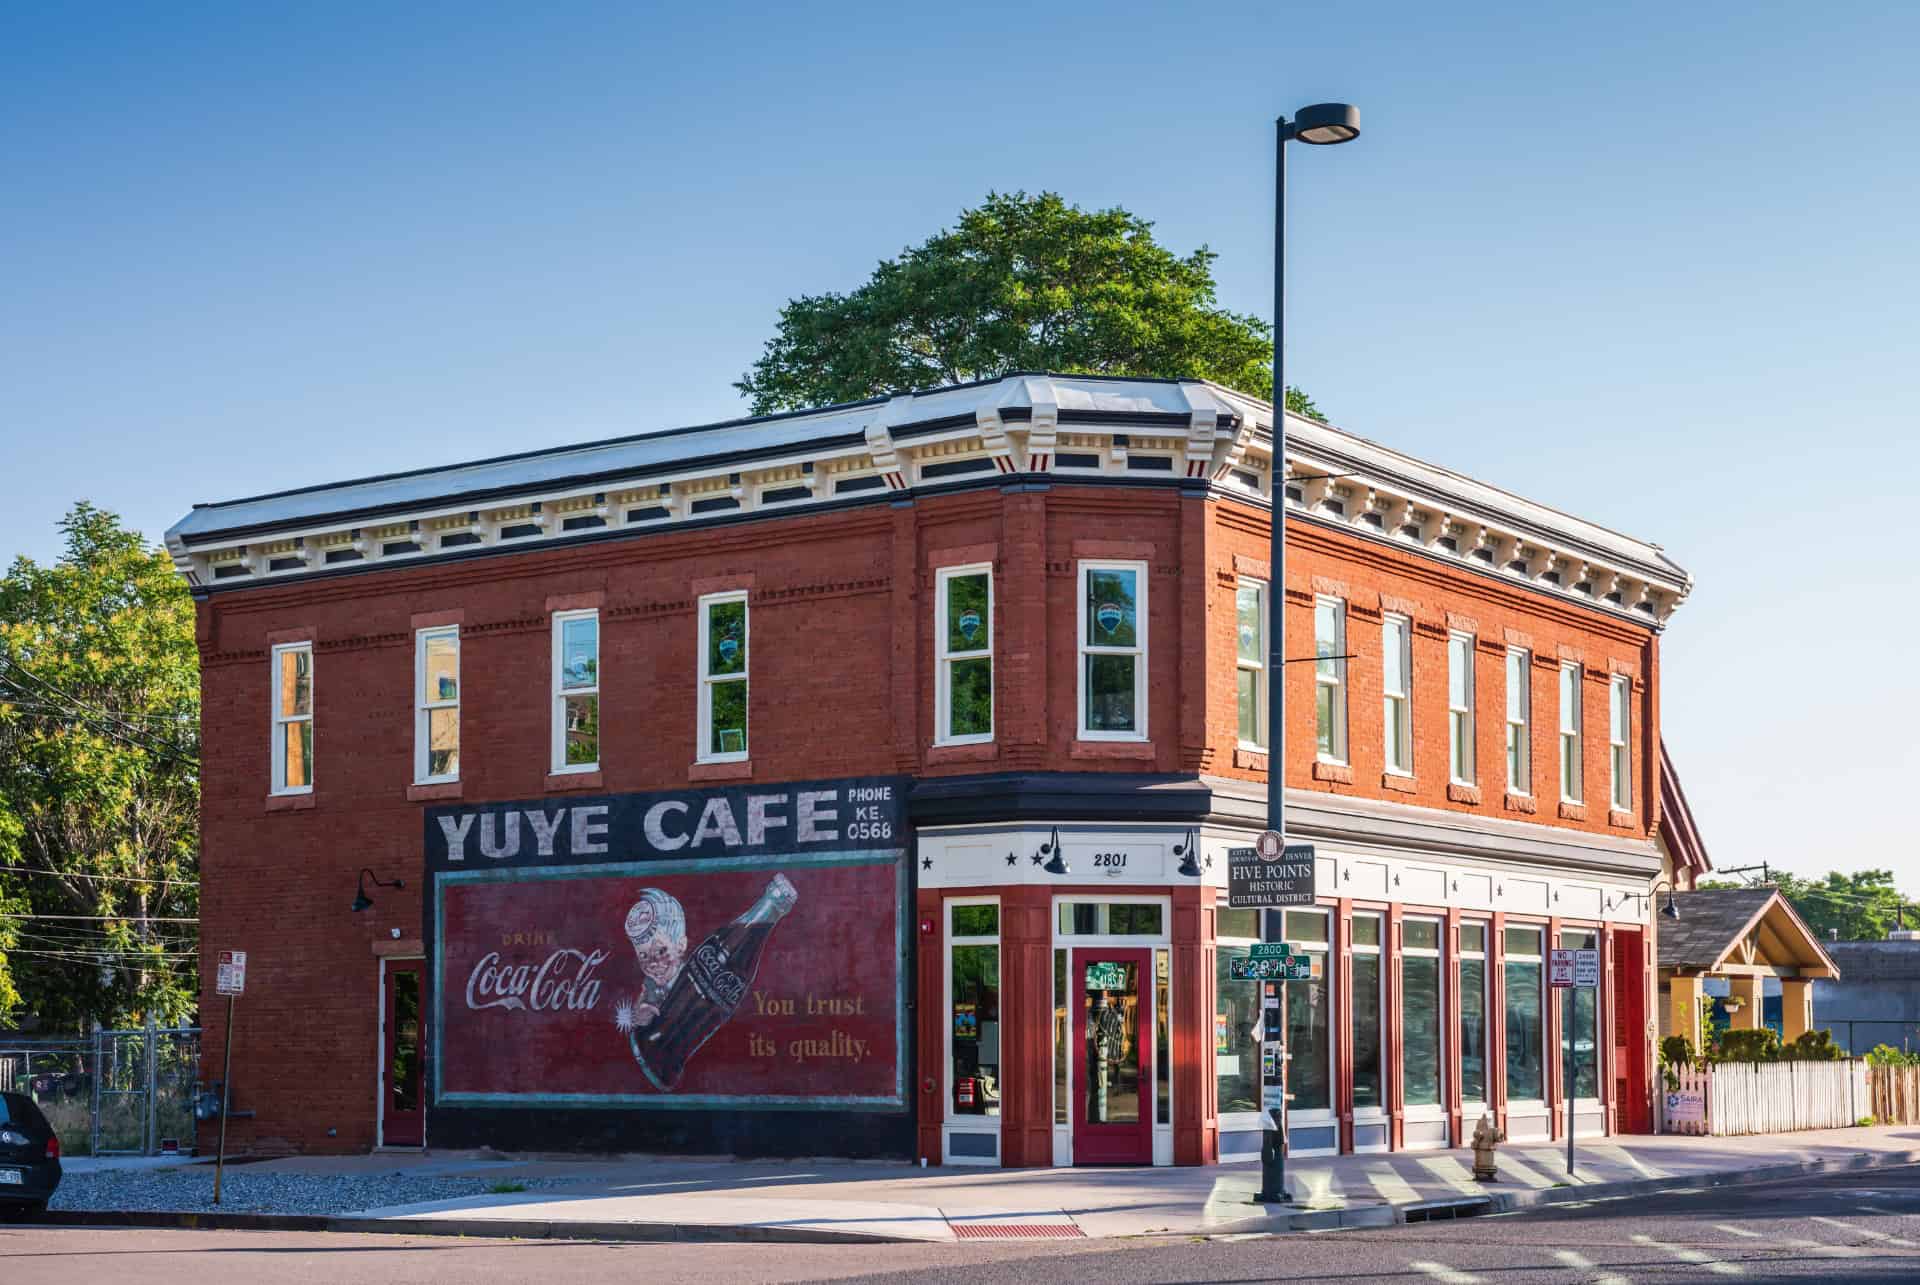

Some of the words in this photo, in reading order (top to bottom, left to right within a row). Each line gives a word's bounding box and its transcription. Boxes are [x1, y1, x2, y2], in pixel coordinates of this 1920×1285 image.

[848, 787, 891, 802] PHONE
[856, 806, 884, 820] KE.
[437, 805, 609, 861] YUYE
[643, 790, 839, 851] CAFE
[848, 822, 891, 839] 0568
[1094, 853, 1127, 866] 2801
[1232, 866, 1261, 880] FIVE
[1266, 864, 1312, 879] POINTS
[1249, 880, 1294, 892] HISTORIC
[1232, 894, 1273, 905] CULTURAL
[1276, 893, 1312, 904] DISTRICT
[1258, 945, 1282, 954] 2800
[465, 949, 610, 1010] Coca-Cola
[752, 991, 795, 1016] You
[807, 991, 865, 1016] trust
[749, 1032, 777, 1057] its
[789, 1030, 871, 1064] quality.
